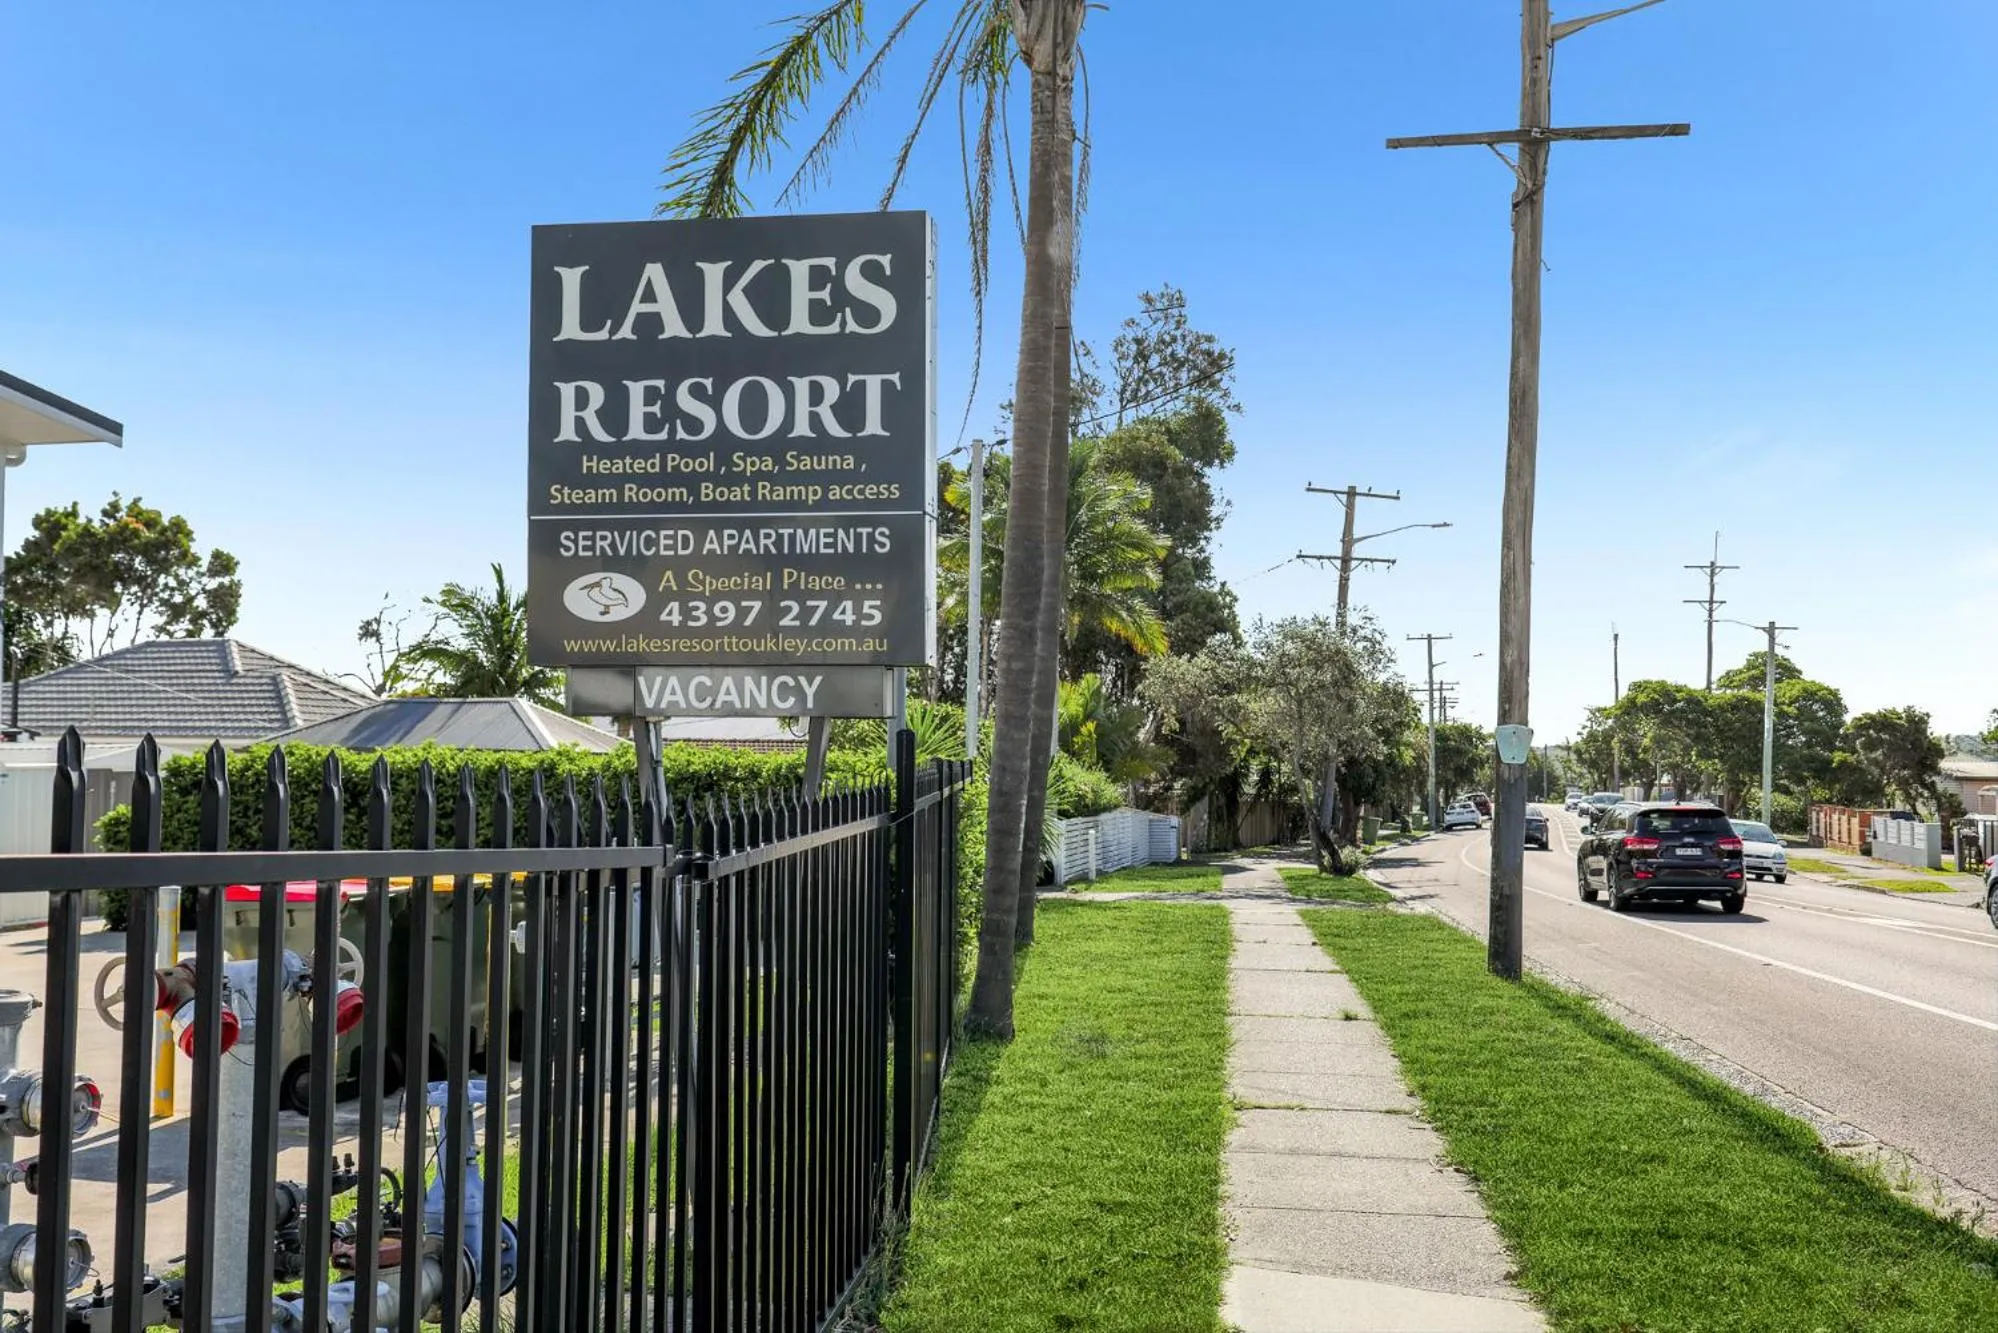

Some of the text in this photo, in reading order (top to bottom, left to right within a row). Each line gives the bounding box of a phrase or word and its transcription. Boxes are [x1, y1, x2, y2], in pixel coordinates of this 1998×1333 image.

[552, 253, 898, 342] LAKES
[552, 371, 902, 443] RESORT
[582, 452, 661, 475] Heated
[732, 451, 779, 477] Spa,
[550, 481, 900, 505] Steam Room, Boat Ramp access
[559, 526, 891, 557] SERVICED APARTMENTS
[658, 569, 679, 592] A
[686, 569, 772, 596] Special
[783, 567, 846, 591] Place
[659, 600, 884, 628] 4397 2745
[563, 632, 888, 657] www.lakesresorttoukley.com.au
[637, 674, 825, 710] VACANCY
